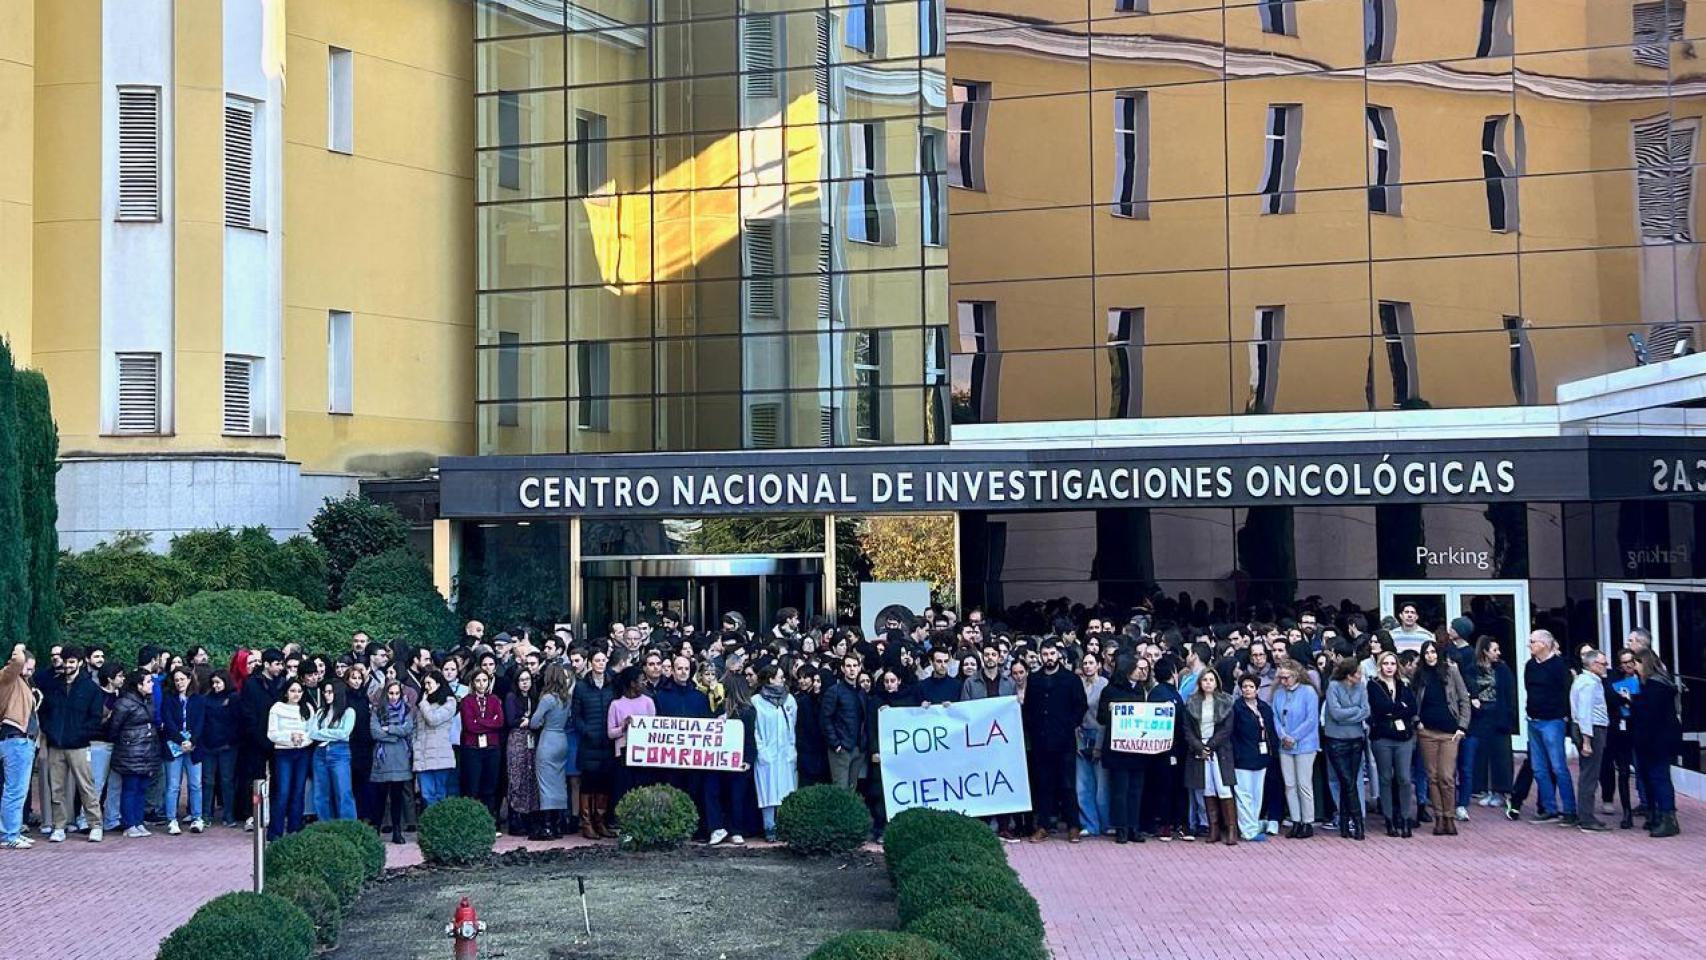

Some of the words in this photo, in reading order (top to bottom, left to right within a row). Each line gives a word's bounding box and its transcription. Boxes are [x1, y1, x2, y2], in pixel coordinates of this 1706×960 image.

[519, 475, 660, 508] CENTRO
[672, 472, 857, 505] NACIONAL
[871, 471, 914, 503] DE
[925, 466, 1233, 503] INVESTIGACIONES
[1246, 454, 1516, 498] ONCOLÓGICAS
[1416, 546, 1489, 569] Parking
[630, 718, 647, 730] LA
[651, 718, 701, 732] CIENCIA
[705, 721, 724, 734] ES
[647, 732, 723, 748] NUESTRO
[892, 725, 951, 756] POR
[964, 719, 1009, 748] LA
[892, 768, 1015, 806] CIENCIA
